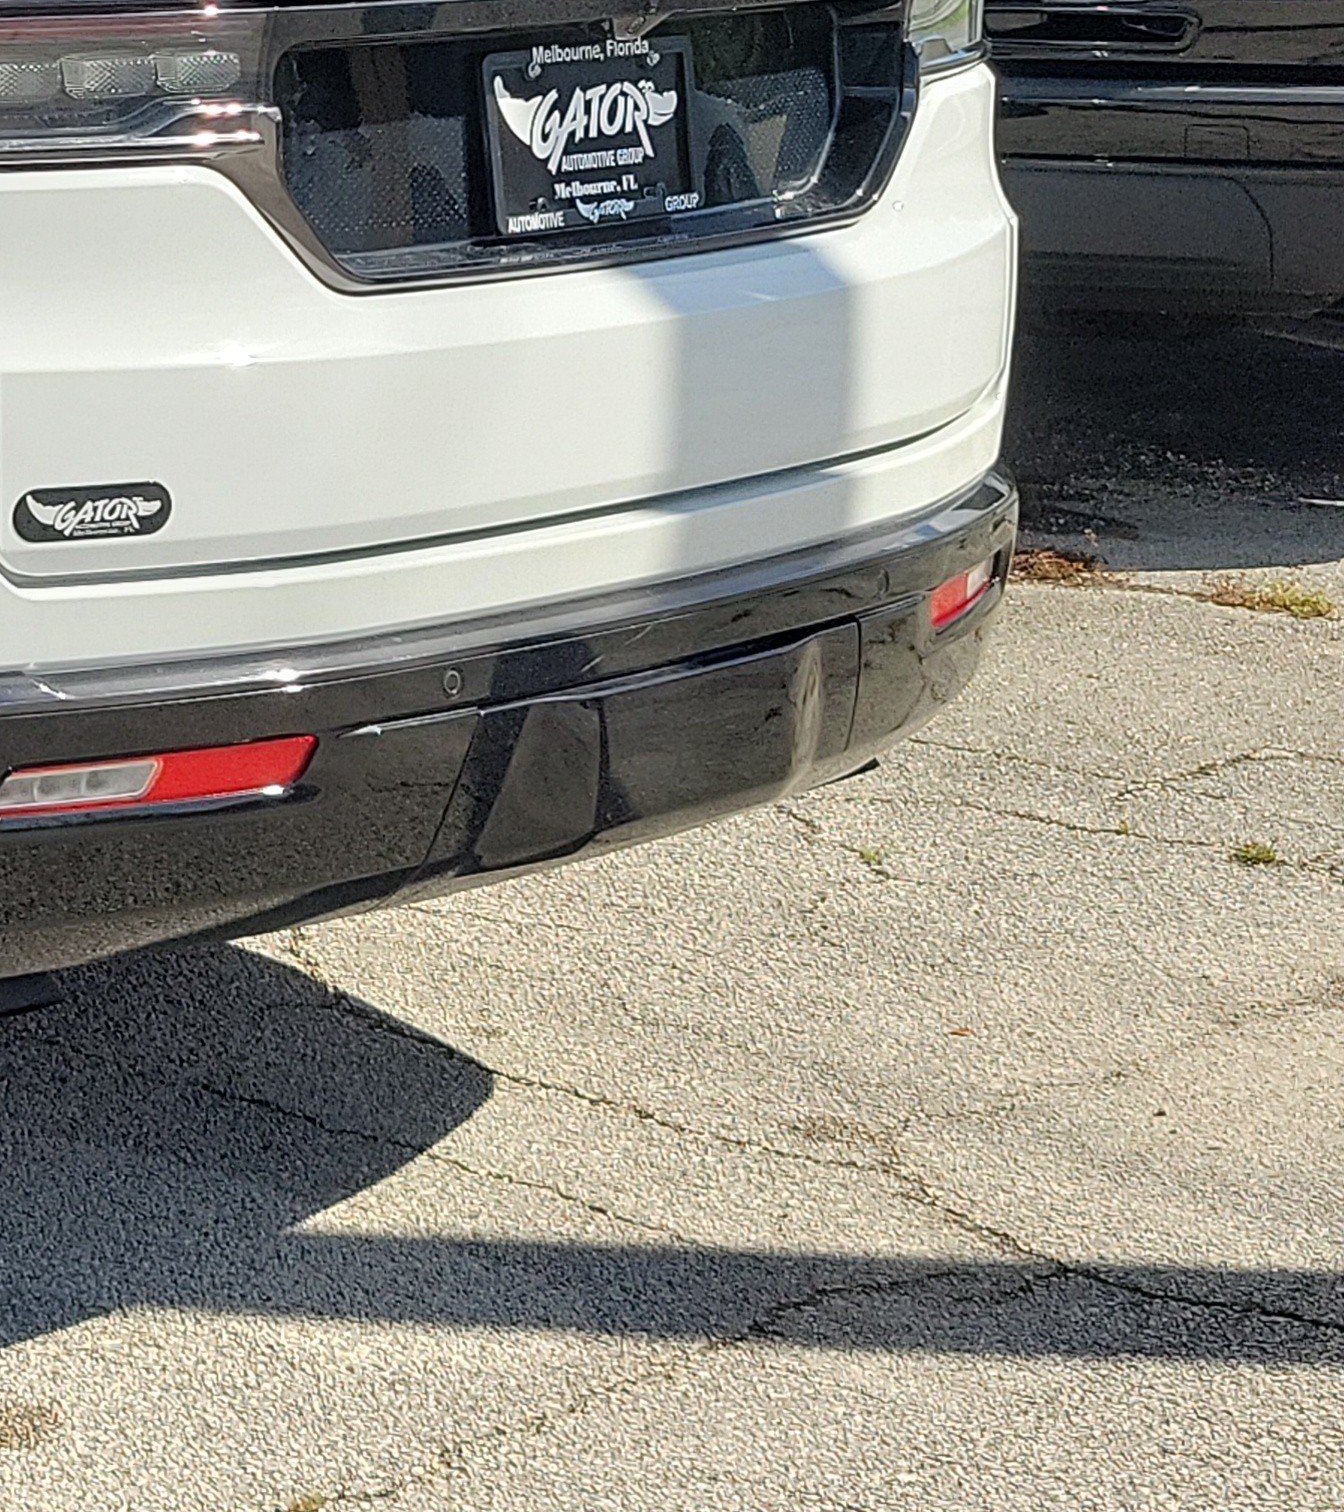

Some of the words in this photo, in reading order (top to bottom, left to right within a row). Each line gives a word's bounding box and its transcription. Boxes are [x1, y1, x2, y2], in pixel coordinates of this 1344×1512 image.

[531, 44, 604, 65] Melbourne,
[606, 39, 649, 58] Florida
[531, 81, 654, 175] GATOR
[561, 150, 616, 172] AUTOMOTIVE
[616, 147, 644, 166] GROUP
[553, 177, 620, 199] Melbourne,
[507, 211, 565, 233] AUTOMOTIVE
[664, 193, 700, 212] GROUP
[54, 496, 141, 537] GATOR
